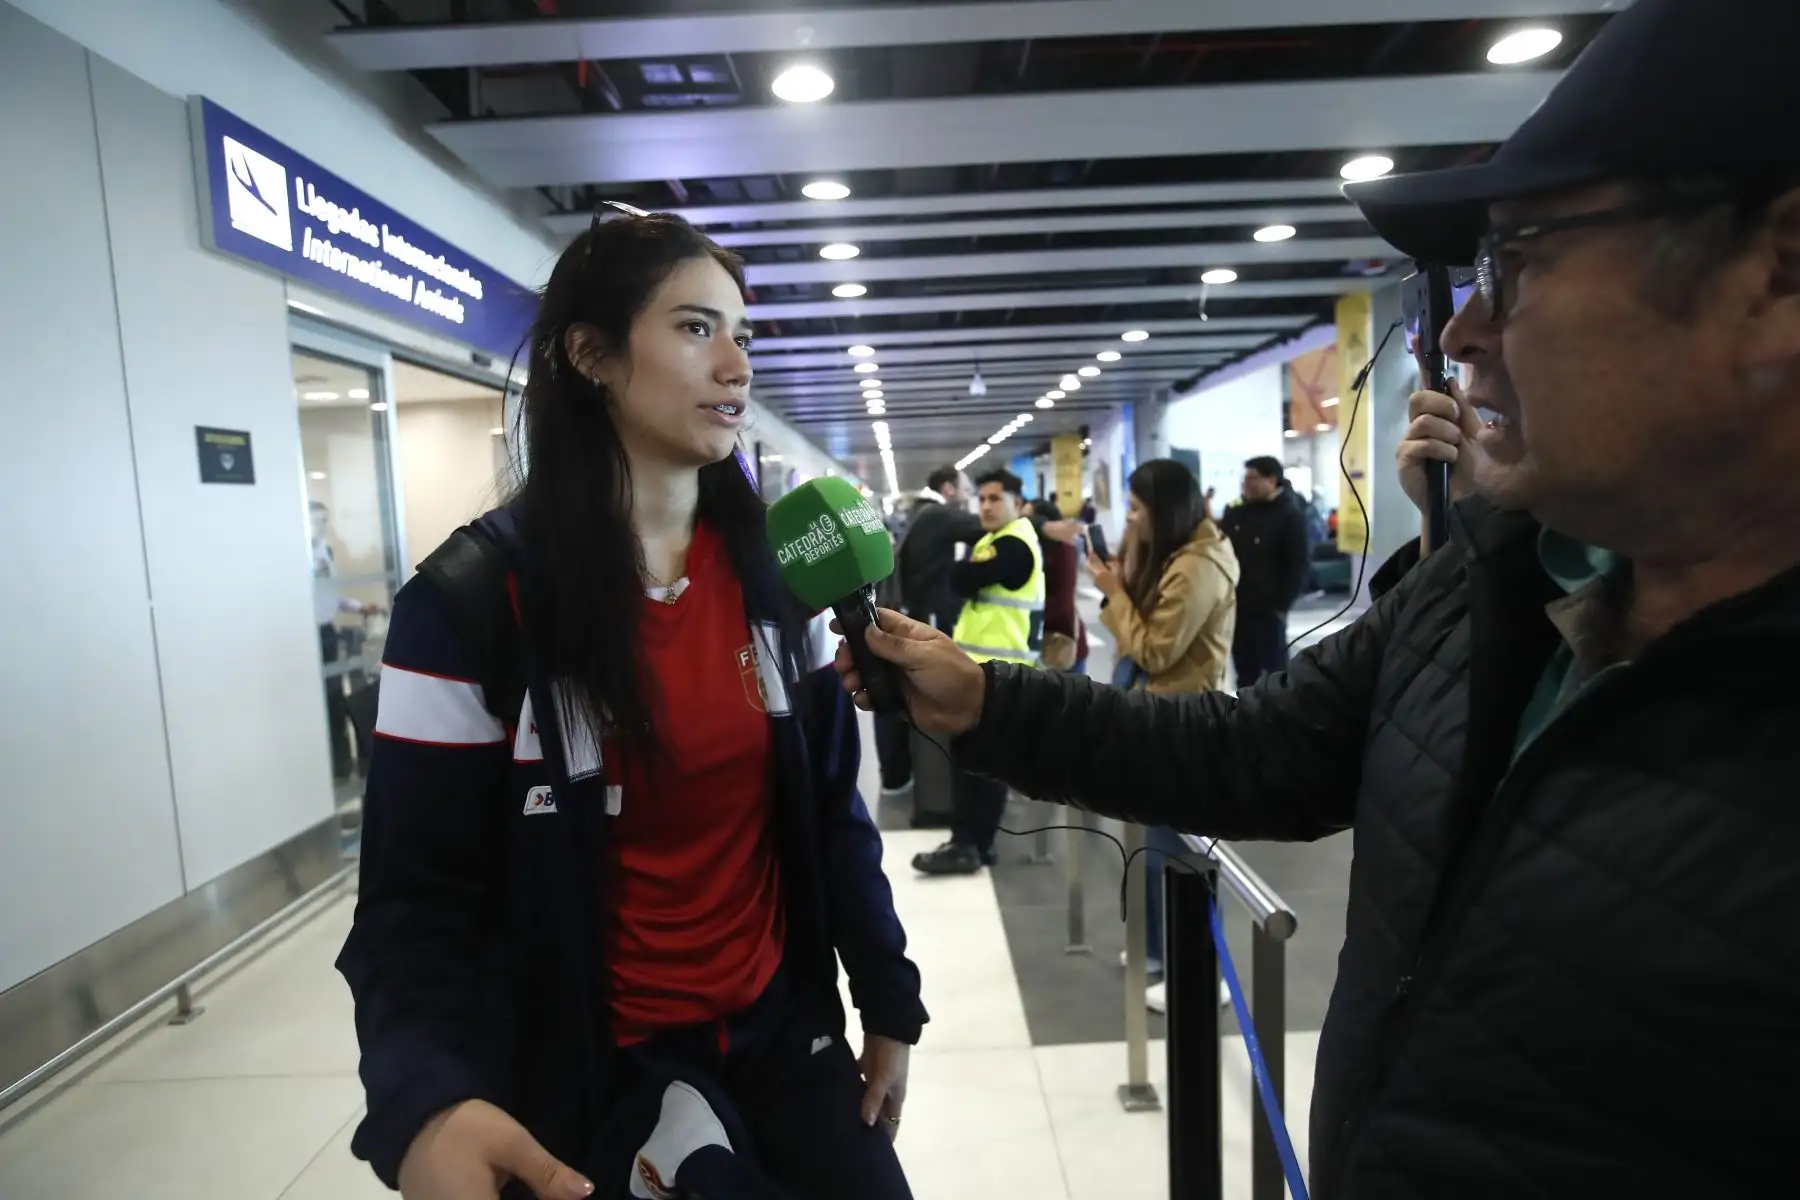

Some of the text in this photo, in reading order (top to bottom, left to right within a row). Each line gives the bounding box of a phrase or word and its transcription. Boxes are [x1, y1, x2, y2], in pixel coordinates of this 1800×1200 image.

[295, 176, 380, 248] Llegadas
[302, 226, 465, 324] International Arrivals
[809, 521, 819, 530] LA
[777, 527, 827, 565] CÁTEDRA
[804, 533, 845, 563] DEPORTES
